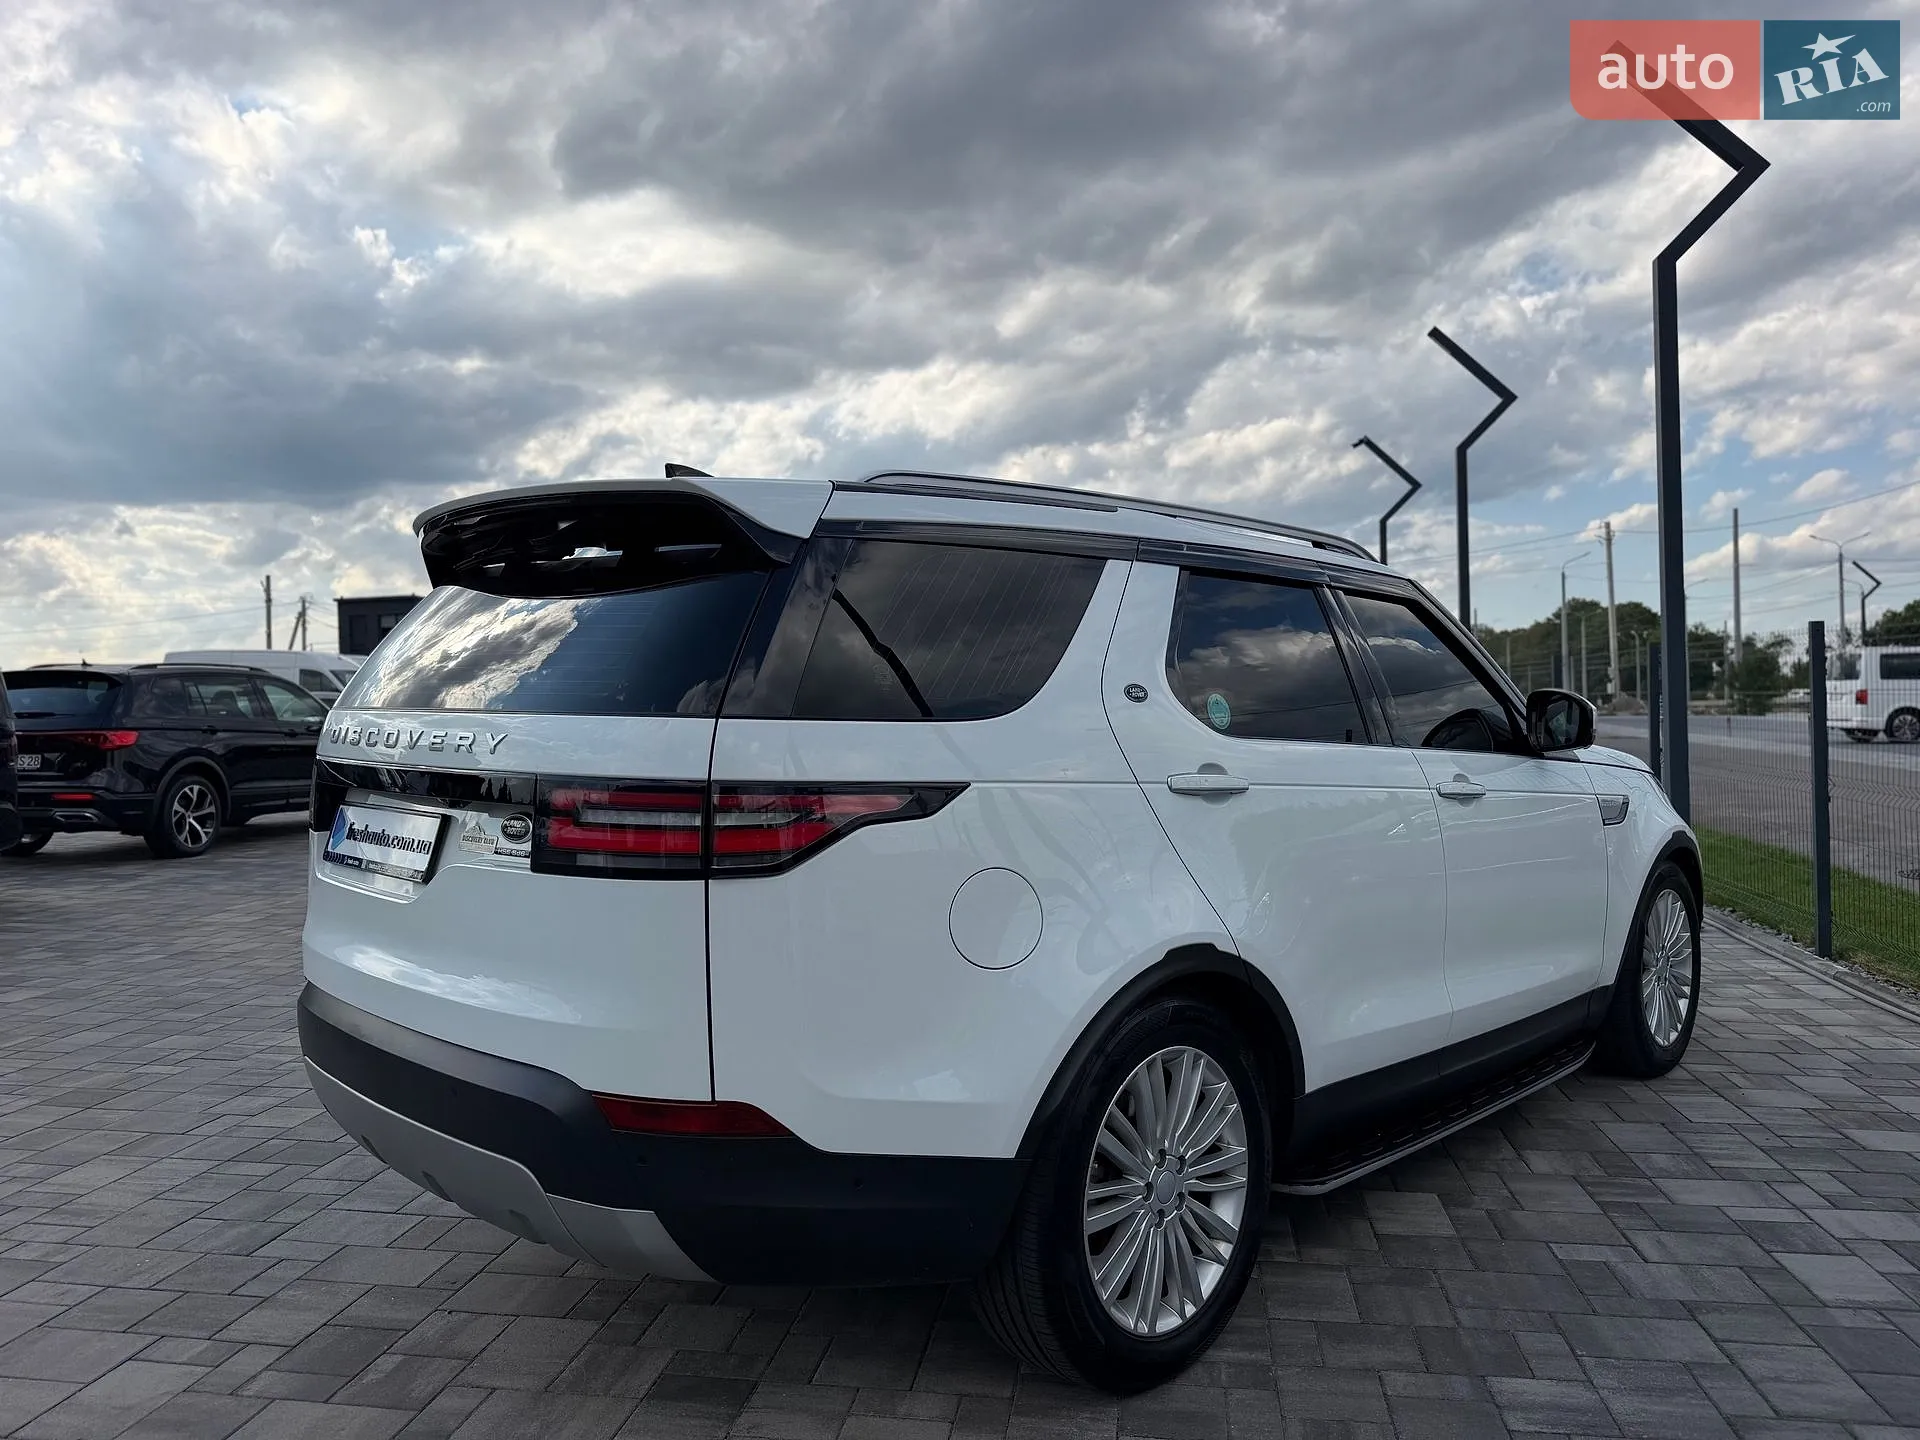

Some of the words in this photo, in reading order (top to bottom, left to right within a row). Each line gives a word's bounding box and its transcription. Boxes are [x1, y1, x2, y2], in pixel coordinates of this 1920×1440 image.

[330, 726, 509, 755] DISCOVERY
[27, 755, 40, 767] 28
[506, 819, 522, 828] LAND
[506, 827, 526, 836] ROVER
[345, 821, 433, 855] freshauto.com.ua
